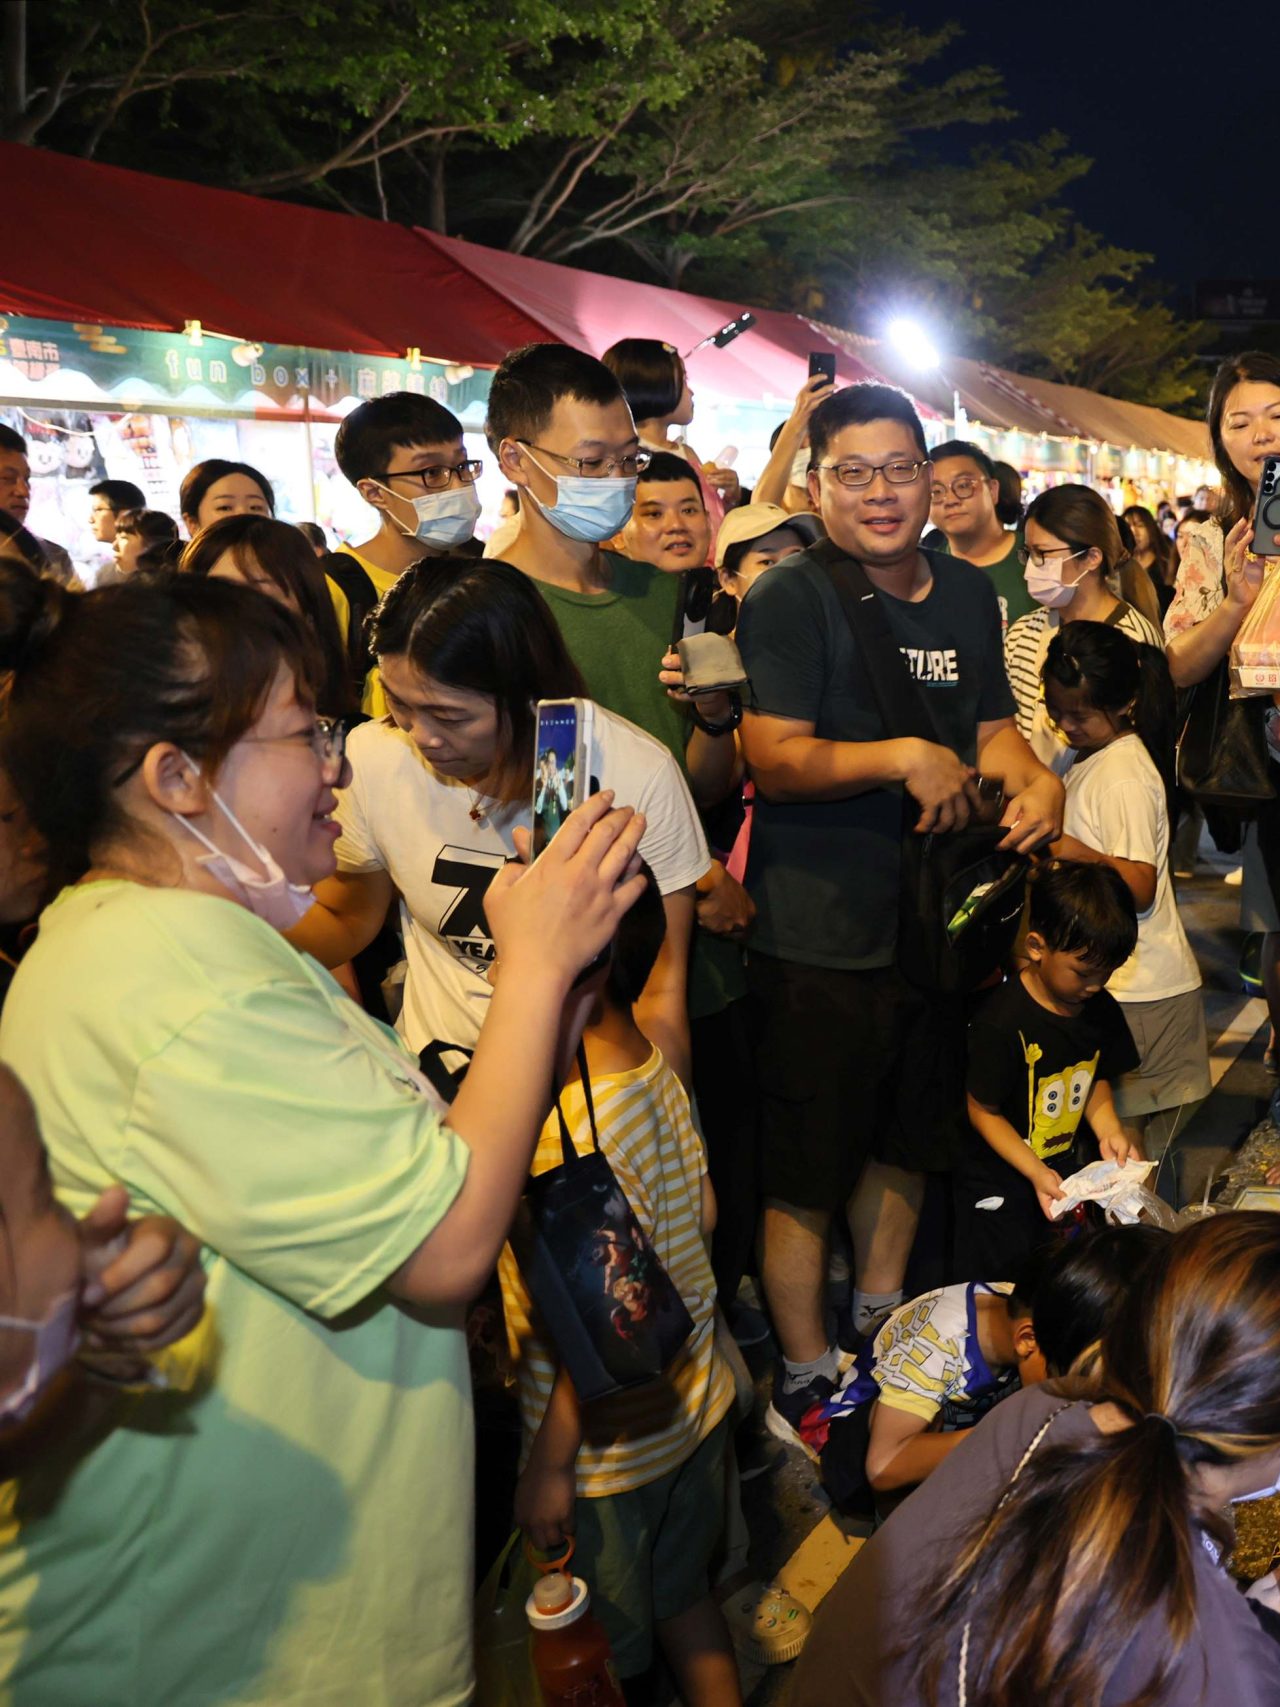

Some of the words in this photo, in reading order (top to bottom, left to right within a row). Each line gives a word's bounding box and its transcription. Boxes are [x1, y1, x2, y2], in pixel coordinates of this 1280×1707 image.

[165, 349, 228, 384] fun
[251, 363, 310, 388] box
[899, 647, 960, 681] TURE
[453, 939, 497, 962] YEA
